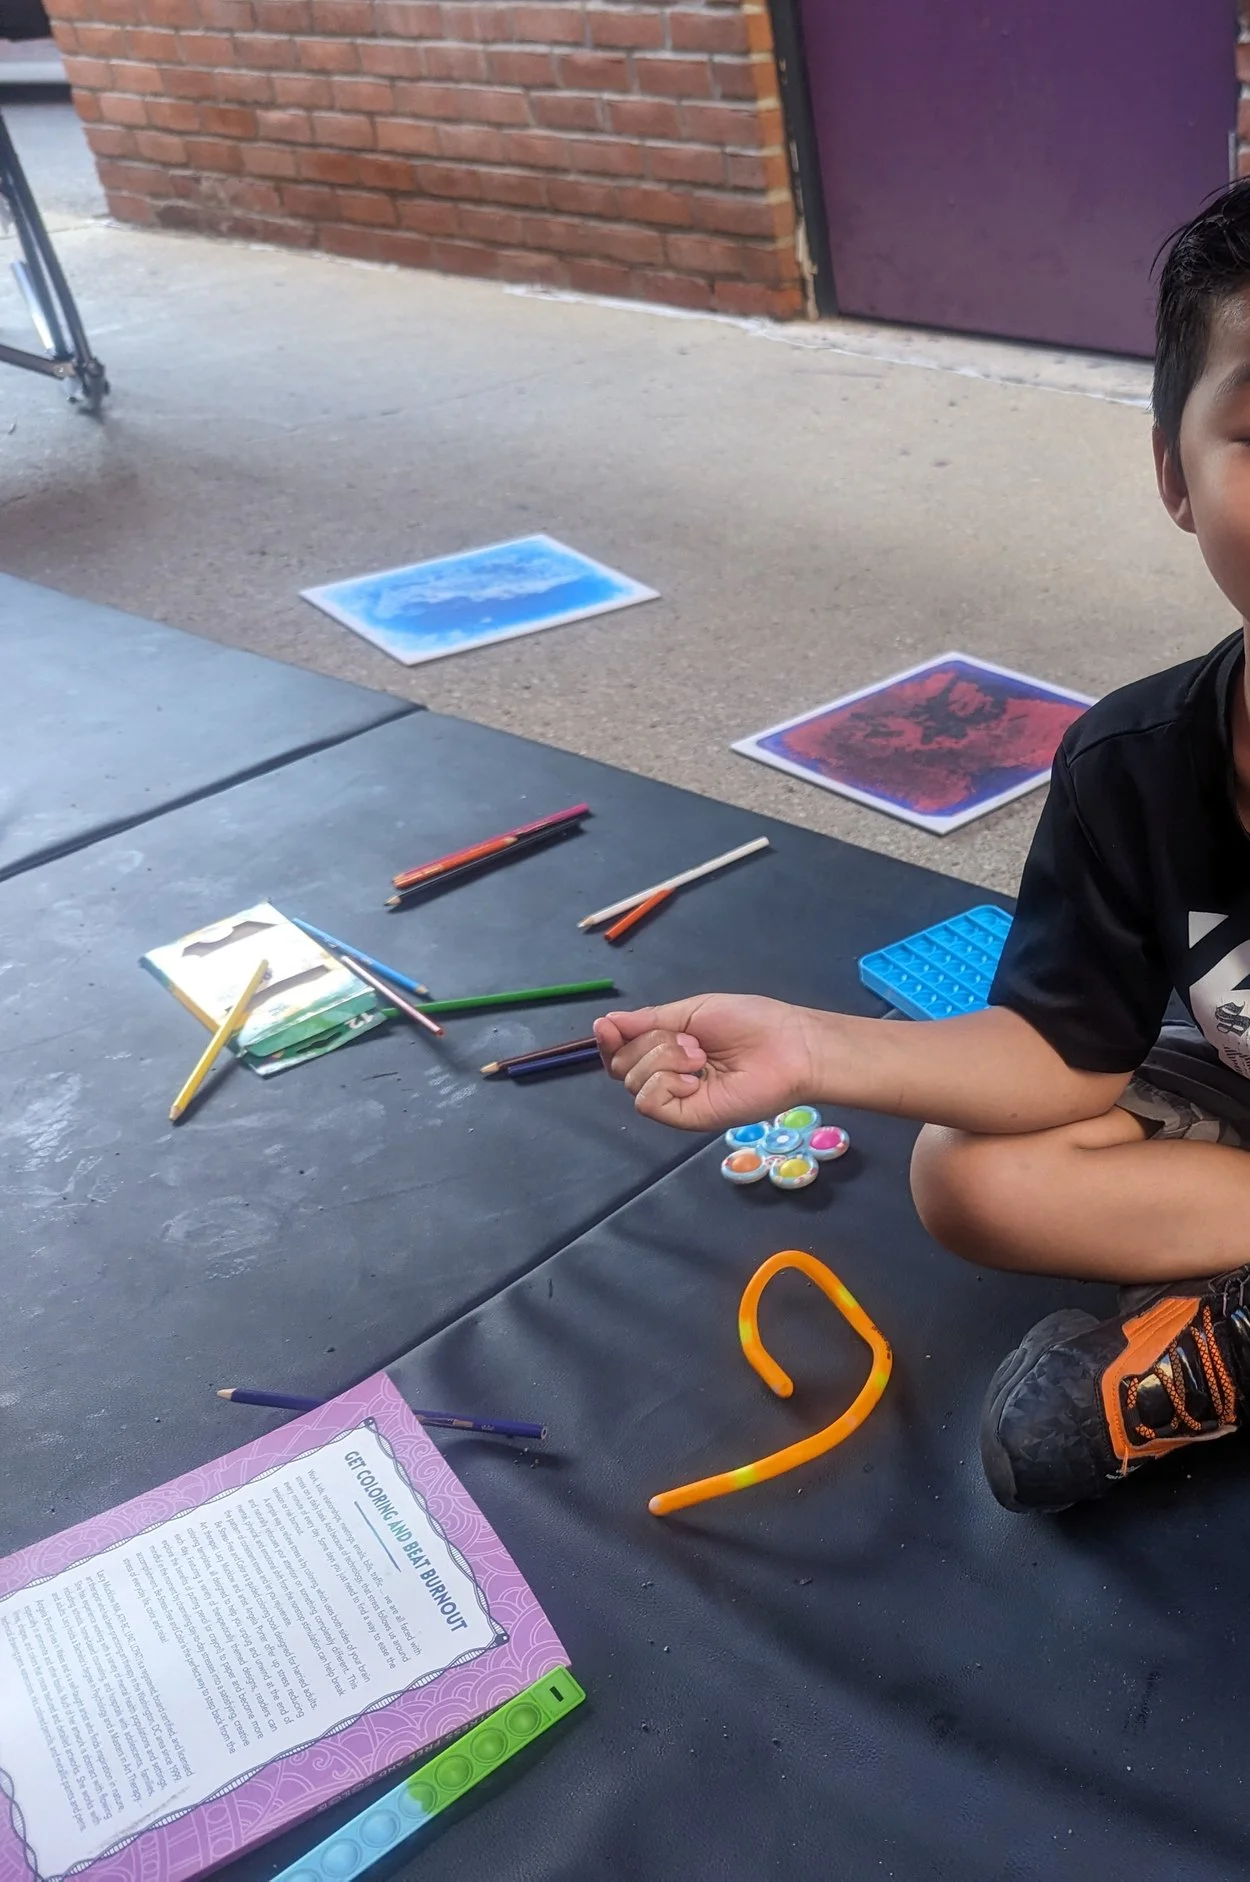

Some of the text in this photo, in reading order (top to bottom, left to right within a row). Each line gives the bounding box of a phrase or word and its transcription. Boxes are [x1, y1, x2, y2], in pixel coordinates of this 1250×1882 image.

[344, 1450, 467, 1632] GET COLORING AND BEAT BURNOUT
[388, 1631, 396, 1639] us
[393, 1638, 411, 1662] around
[400, 1622, 415, 1640] faced
[410, 1640, 423, 1655] with
[348, 1651, 361, 1666] your
[358, 1664, 372, 1682] brain
[378, 1641, 389, 1656] ease
[386, 1656, 398, 1668] the
[292, 1665, 309, 1687] harried
[321, 1662, 337, 1678] help
[331, 1676, 346, 1695] break
[347, 1675, 360, 1688] This
[238, 1692, 256, 1719] become
[251, 1720, 263, 1738] more
[255, 1691, 272, 1716] readers
[267, 1719, 277, 1731] can
[270, 1688, 282, 1700] the
[276, 1700, 289, 1714] end
[284, 1715, 293, 1723] of
[284, 1687, 307, 1718] reducing
[211, 1708, 225, 1725] back
[219, 1724, 232, 1741] from
[226, 1740, 238, 1753] the
[233, 1719, 252, 1746] creative
[377, 1759, 405, 1778] AND
